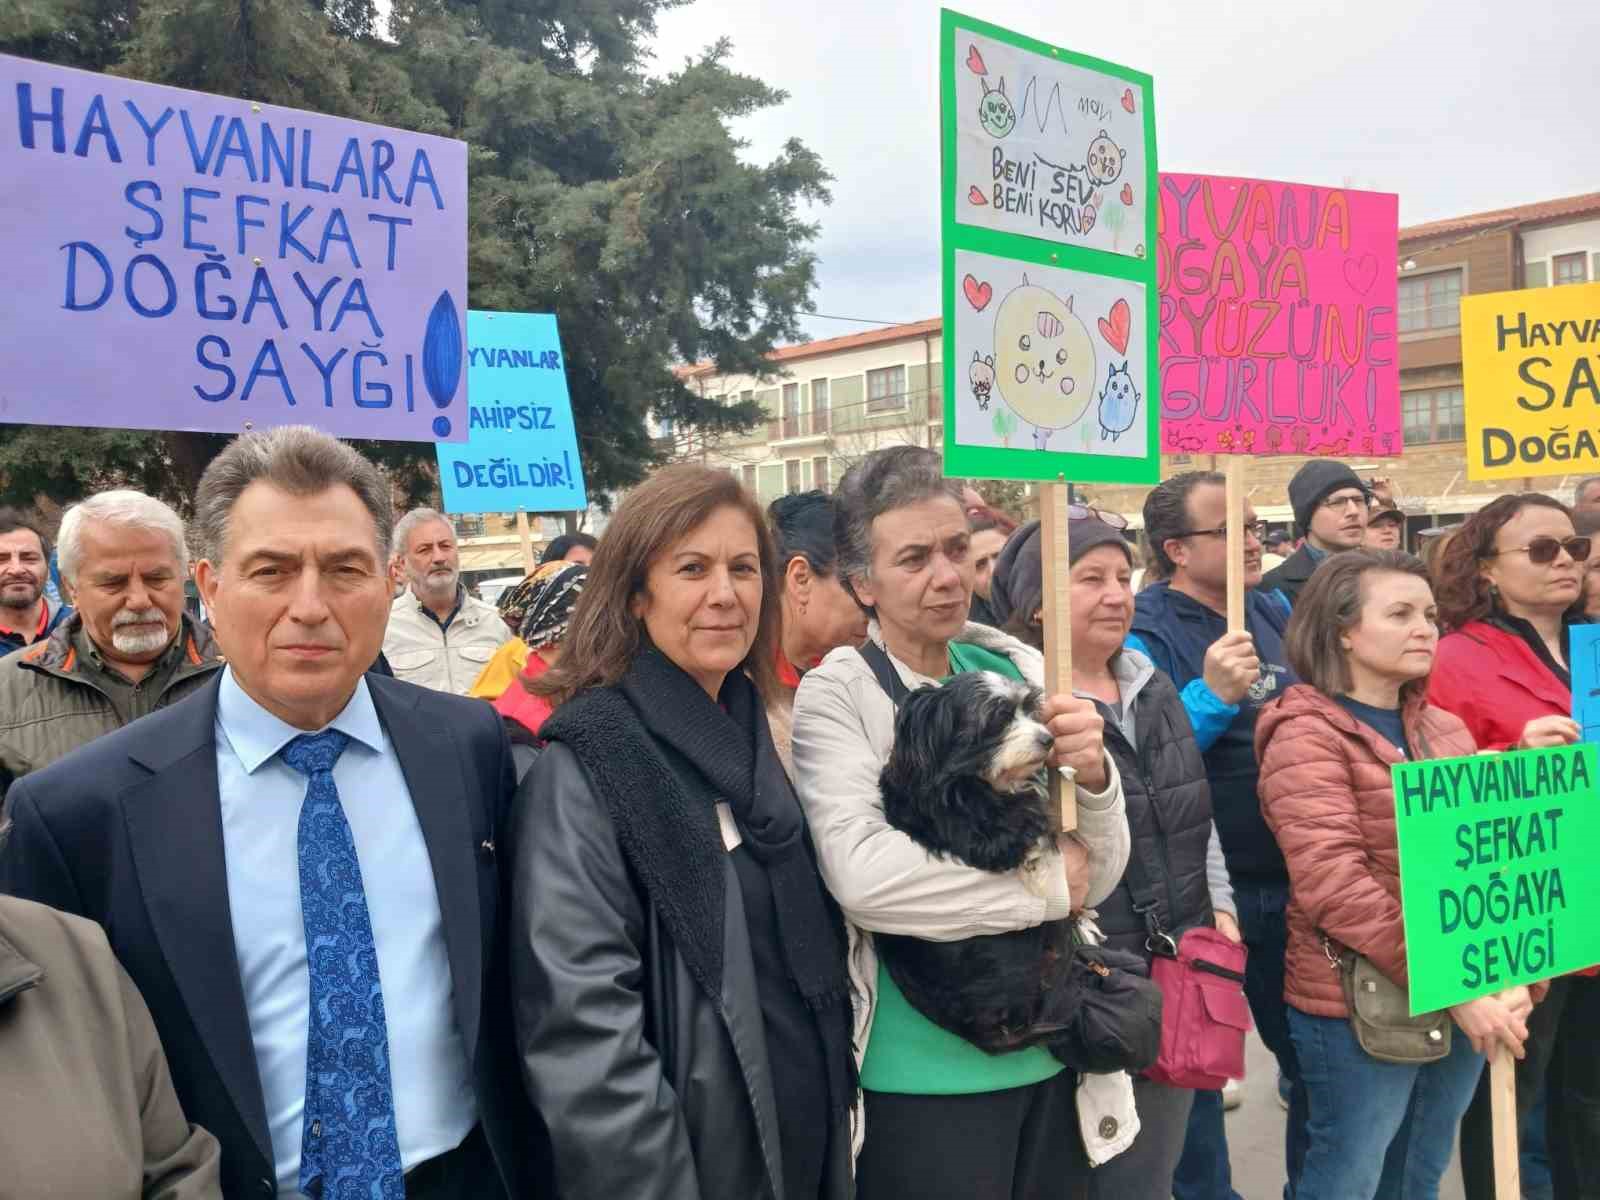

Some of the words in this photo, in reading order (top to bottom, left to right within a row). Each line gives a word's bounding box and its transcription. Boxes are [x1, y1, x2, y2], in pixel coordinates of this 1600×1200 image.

[16, 82, 444, 210] HAYVANLARA
[993, 183, 1034, 216] BENİ
[1039, 197, 1083, 235] KORU
[1050, 171, 1094, 206] SEV
[1158, 176, 1349, 251] YVANA
[124, 180, 413, 271] ŞEFKAT
[60, 241, 384, 338] DOĞAYA
[467, 348, 561, 371] YVANLAR
[1158, 294, 1393, 368] RYÜZÜNE
[469, 399, 555, 430] AHİPSİZ
[1159, 354, 1377, 433] GÜRLÜK!
[1516, 354, 1600, 412] SA
[453, 449, 575, 490] DEĞİLDİR!
[1482, 423, 1600, 468] DOĞA
[1401, 749, 1590, 817] HAYVANLARA
[1455, 808, 1563, 871] ŞEFKAT
[1439, 868, 1566, 935] DOĞAYA
[1461, 919, 1555, 990] SEVGİ
